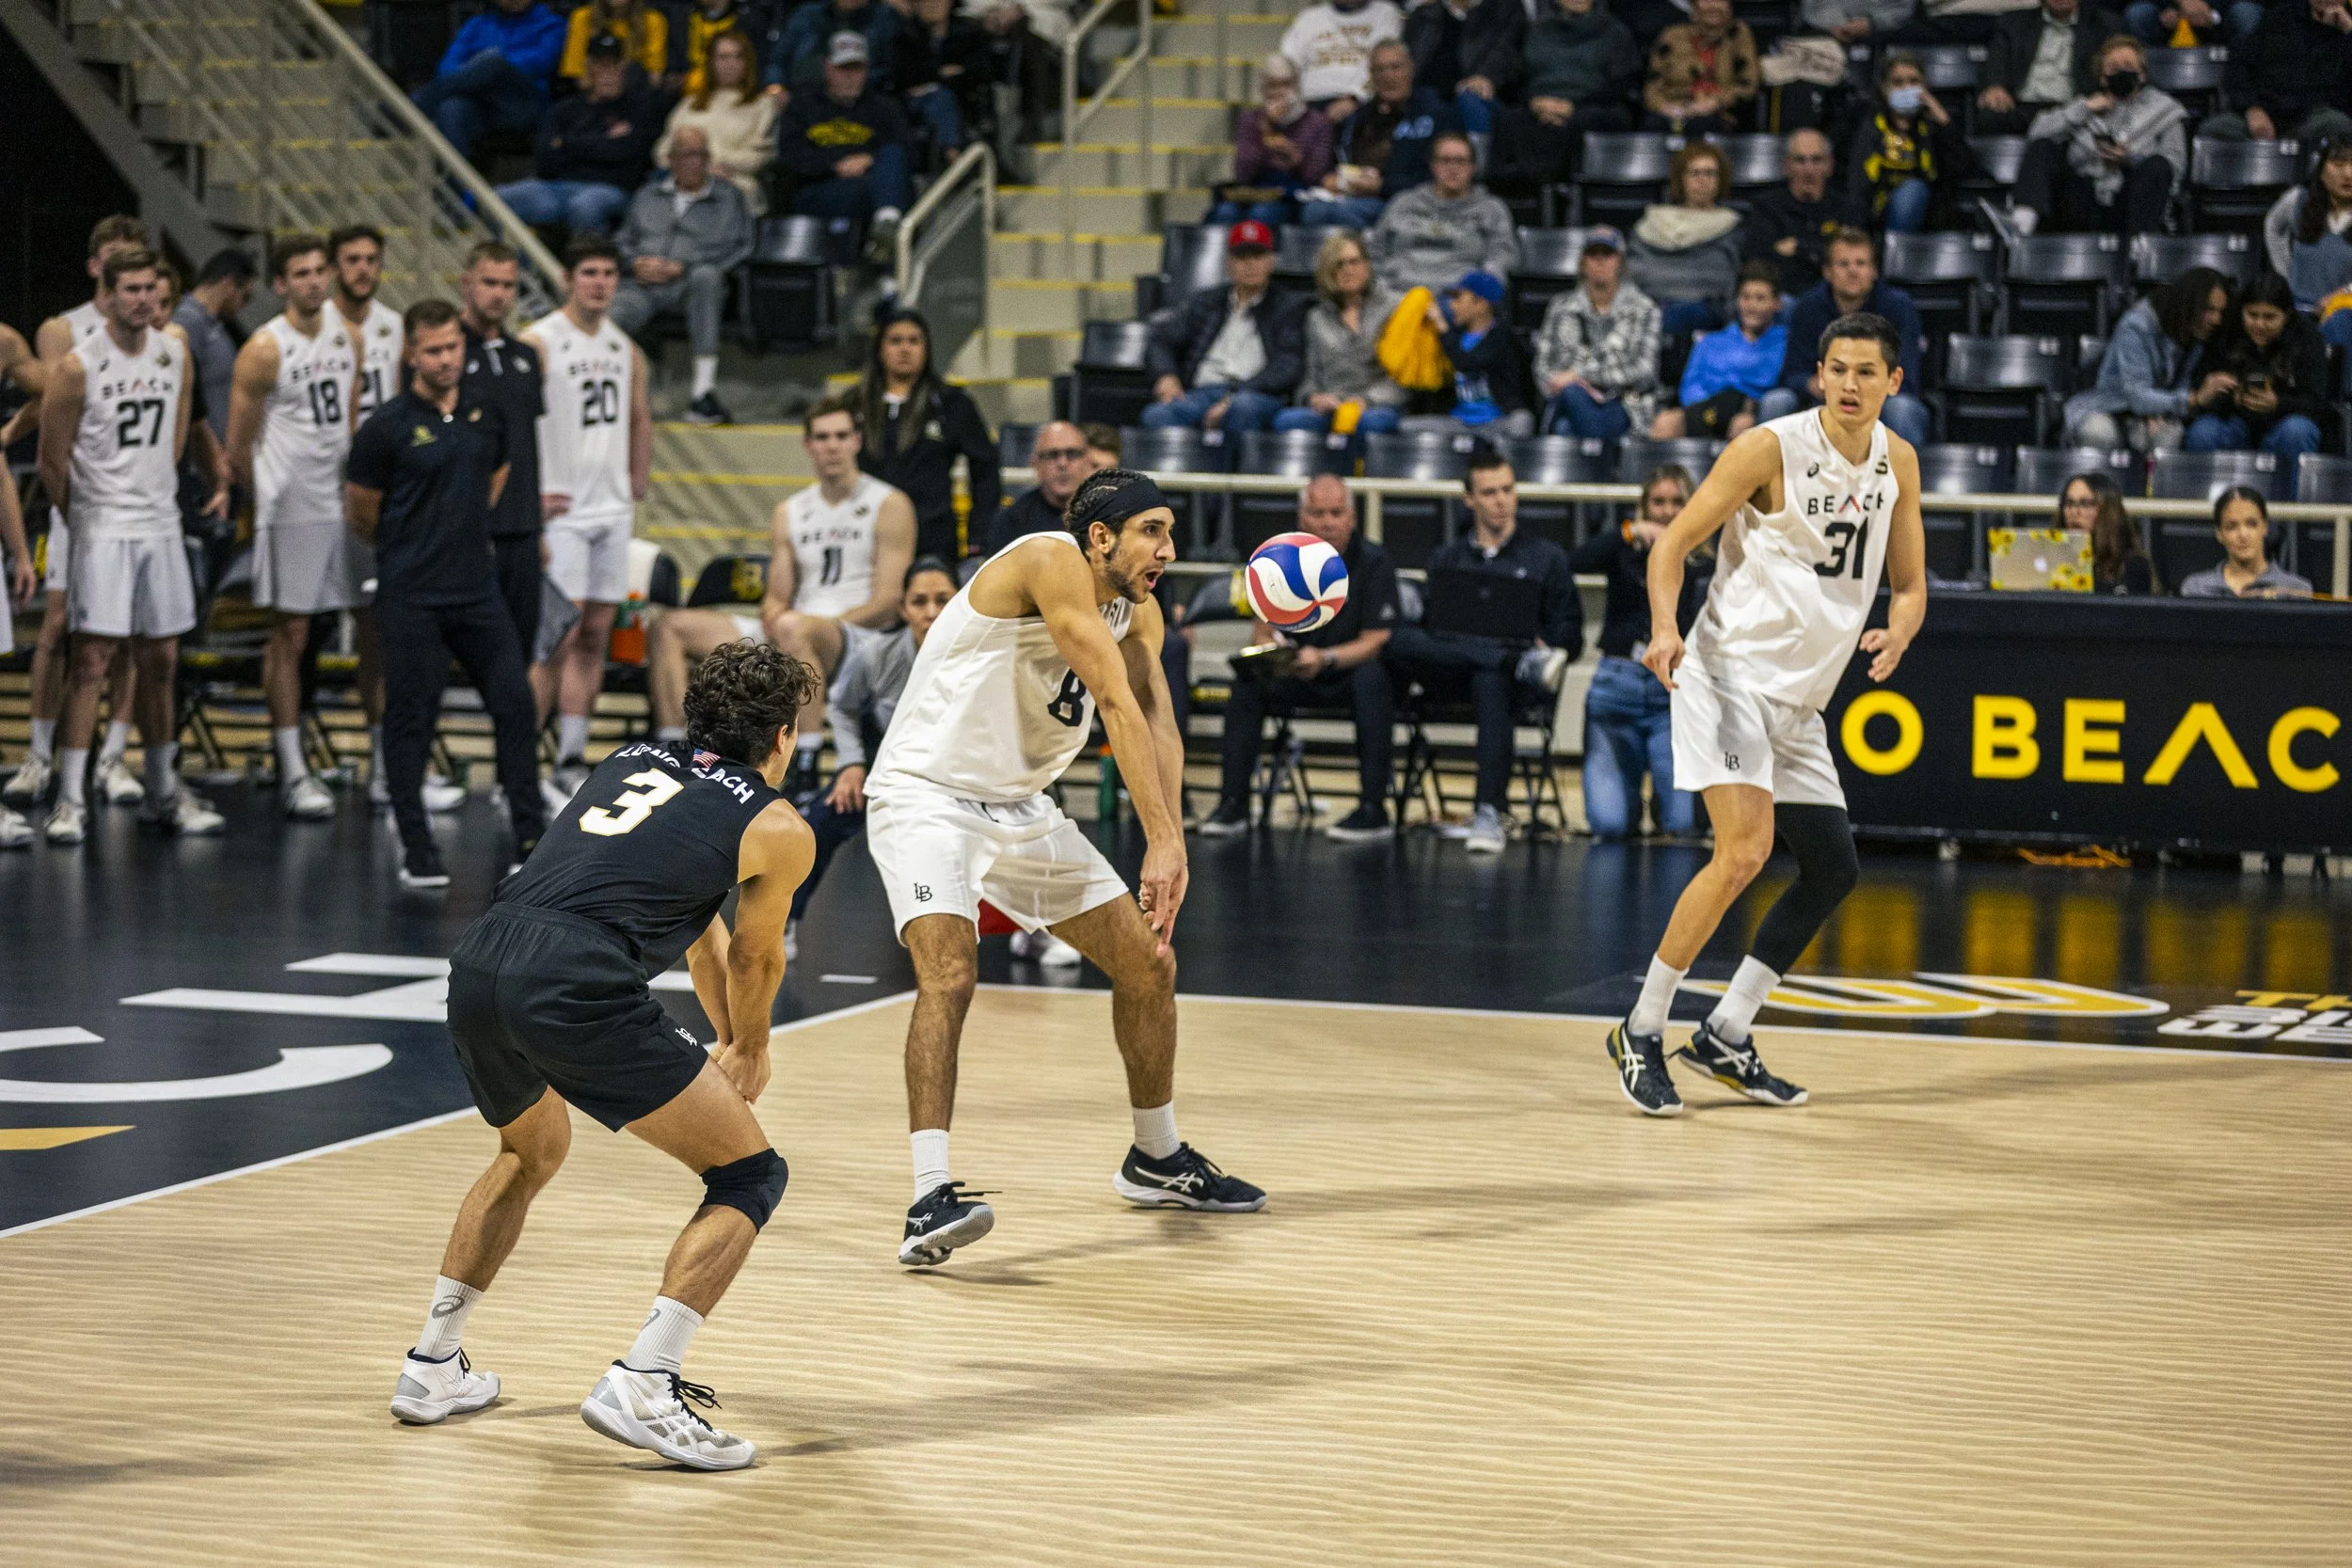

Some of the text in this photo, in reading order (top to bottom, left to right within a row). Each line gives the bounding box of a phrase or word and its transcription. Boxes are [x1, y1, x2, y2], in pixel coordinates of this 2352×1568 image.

[101, 378, 172, 400] BEACH
[308, 378, 342, 426] 18
[581, 379, 619, 428] 20
[118, 399, 165, 447] 27
[1807, 492, 1884, 515] BEACH
[820, 546, 843, 586] 11
[1814, 517, 1868, 579] 31
[1047, 667, 1088, 727] 8
[1972, 694, 2342, 792] BEAC
[579, 768, 685, 836] 3
[691, 768, 755, 805] ACH
[914, 881, 933, 903] LB
